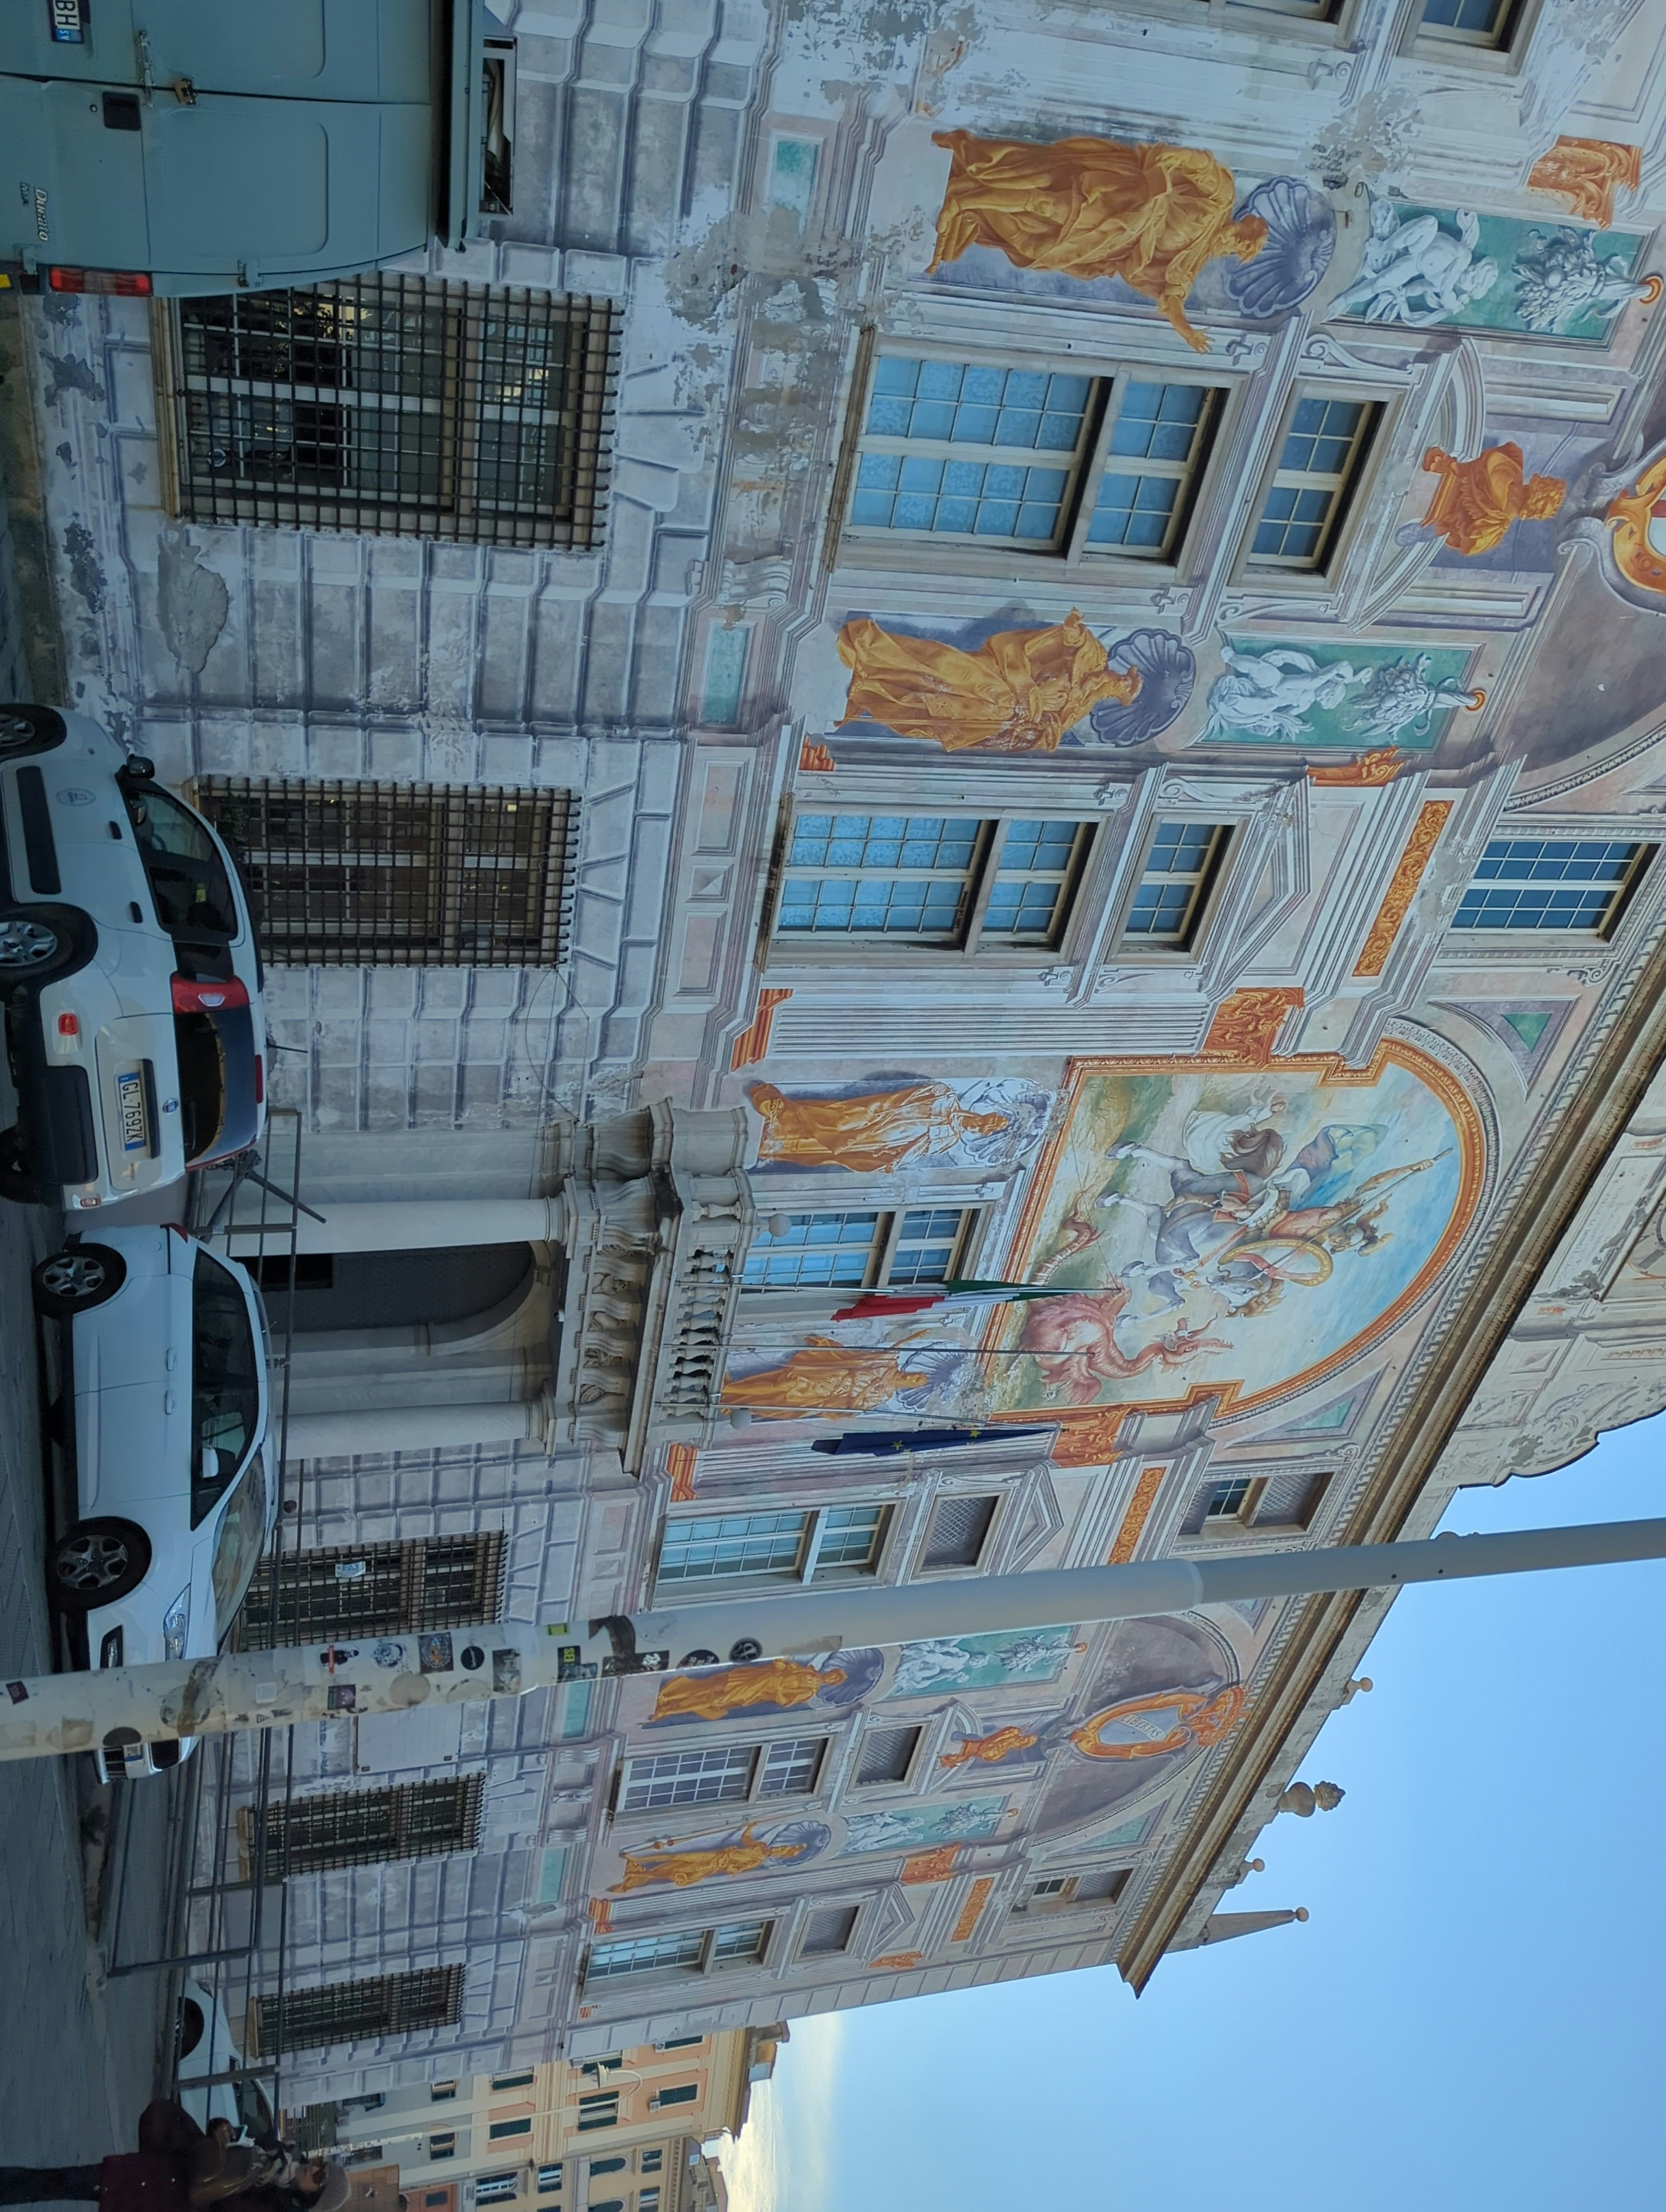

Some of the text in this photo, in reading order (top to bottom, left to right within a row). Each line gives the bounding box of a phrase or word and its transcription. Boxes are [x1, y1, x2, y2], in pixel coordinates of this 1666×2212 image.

[59, 30, 69, 41] SV
[34, 188, 48, 241] Ducato
[1120, 1715, 1162, 1738] LIBERTAS
